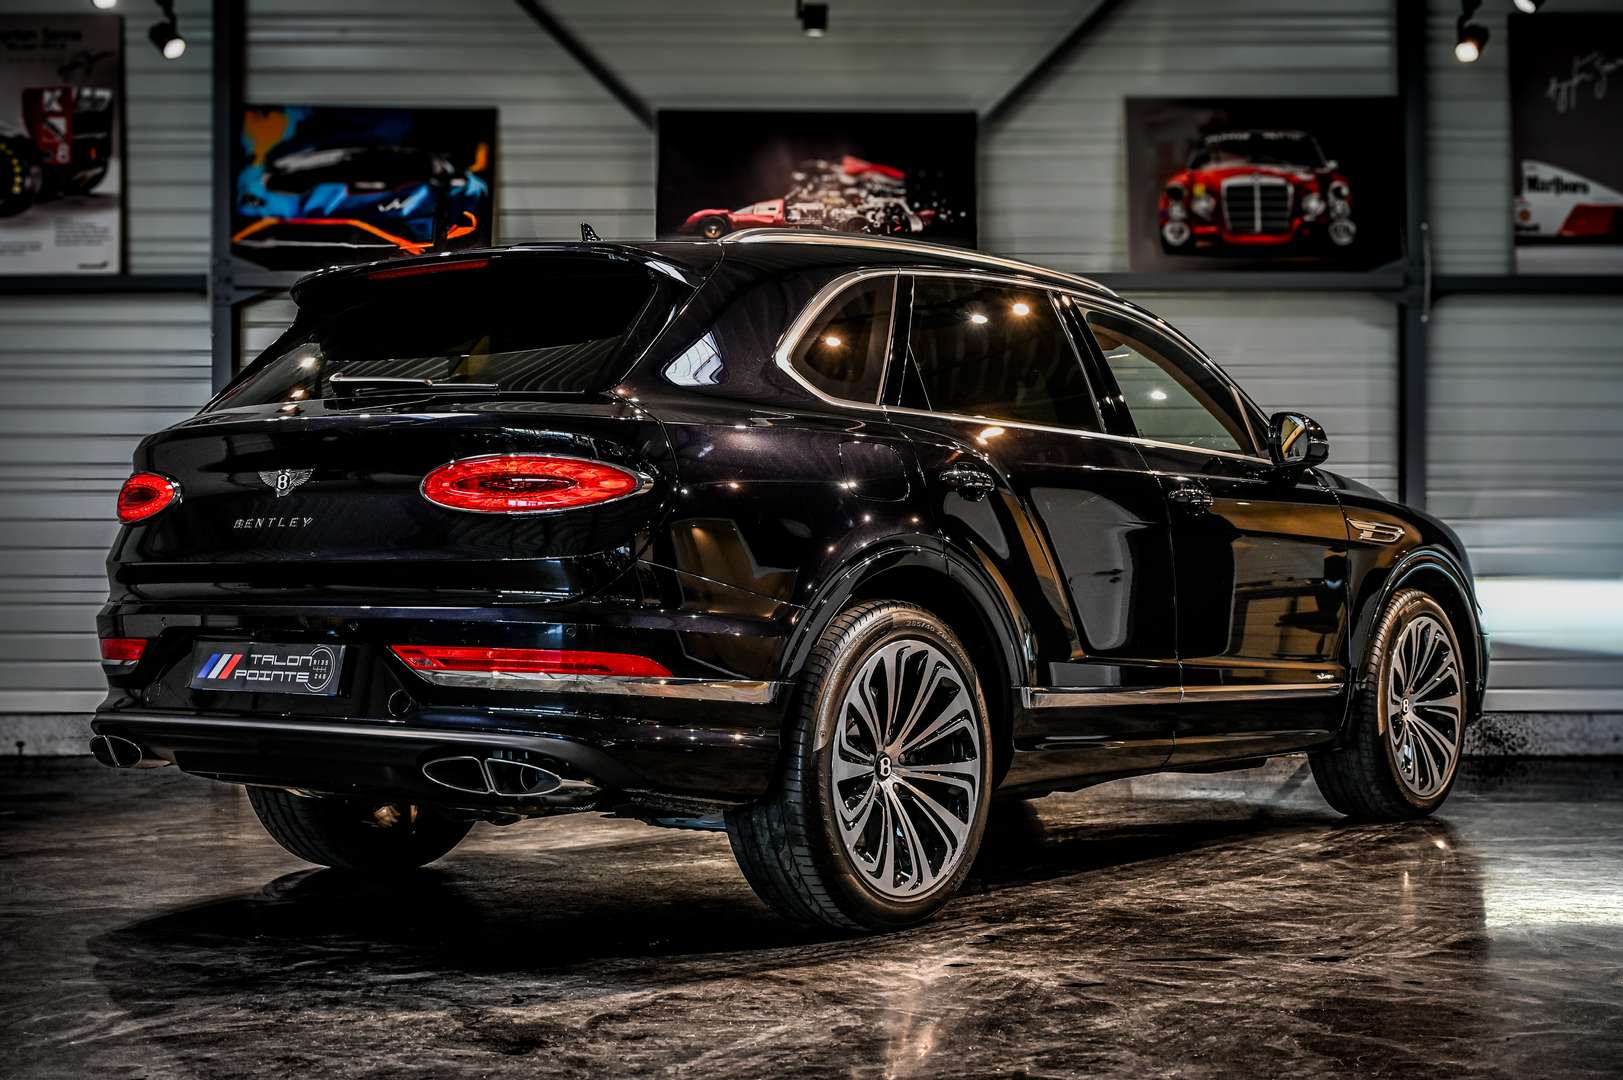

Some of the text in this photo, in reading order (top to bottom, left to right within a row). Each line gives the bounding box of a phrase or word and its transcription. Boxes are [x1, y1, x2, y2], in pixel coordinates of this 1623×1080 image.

[233, 517, 313, 529] BENTLEY
[250, 654, 313, 667] TALON
[234, 669, 310, 683] POINTE
[879, 757, 892, 777] B
